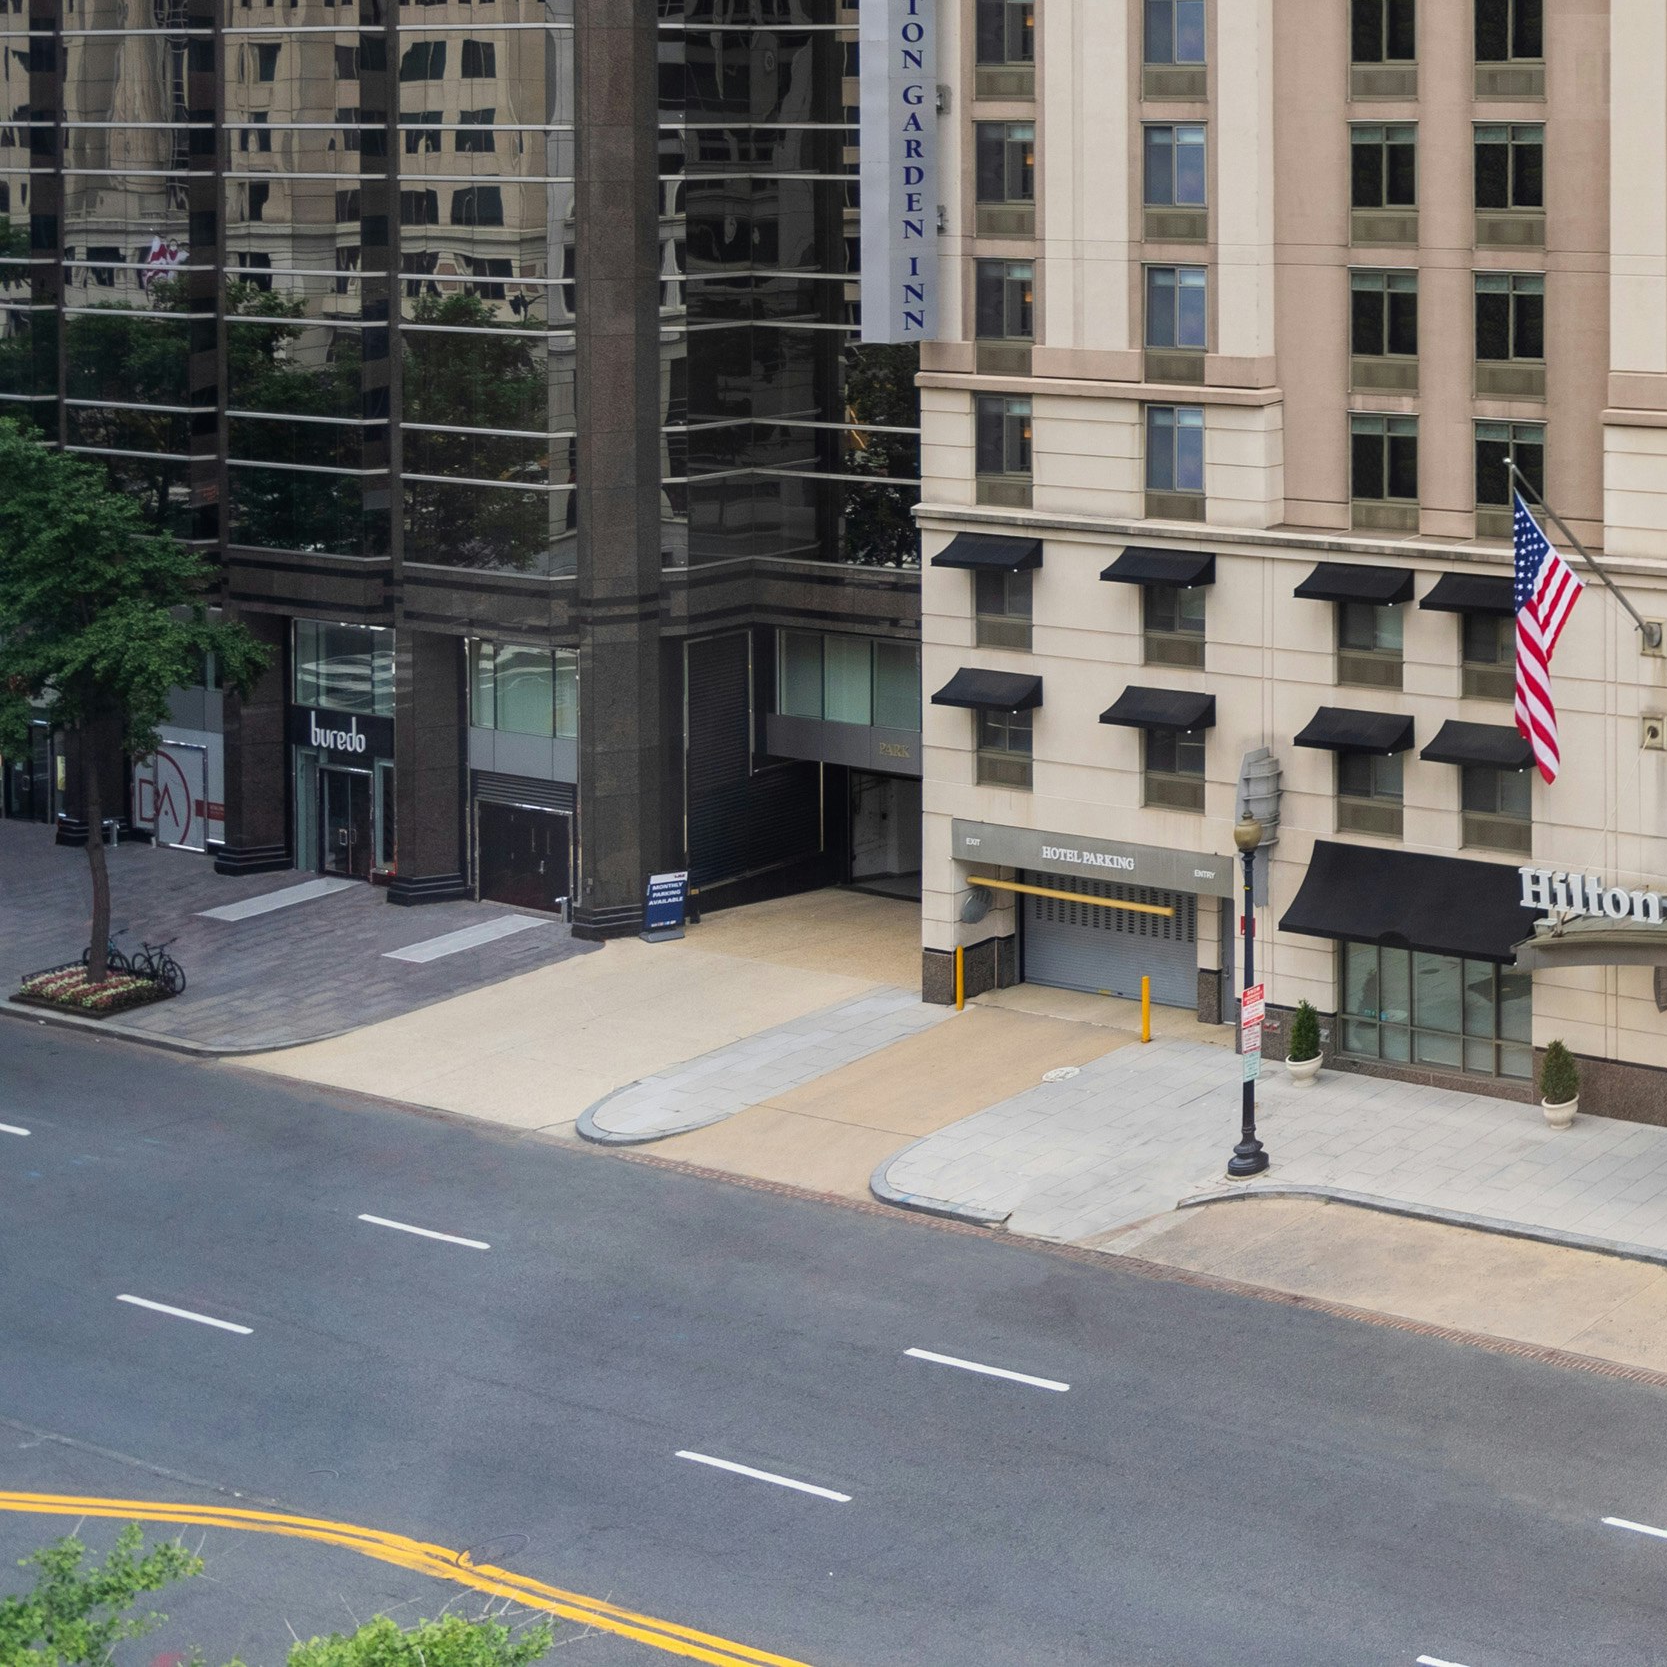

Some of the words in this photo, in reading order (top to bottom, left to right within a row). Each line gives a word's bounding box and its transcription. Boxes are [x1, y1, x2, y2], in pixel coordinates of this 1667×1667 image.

[902, 85, 924, 239] GARDEN
[902, 257, 925, 330] INN
[310, 710, 366, 753] buredo
[966, 837, 980, 846] EXIT
[1042, 846, 1082, 863] HOTEL
[1083, 851, 1135, 870] PARKING
[1194, 869, 1216, 879] ENTRY
[652, 882, 683, 890] MONTHLY
[652, 889, 681, 898] PARKING
[648, 896, 683, 906] AVAILABLE
[1518, 867, 1663, 924] Hilton
